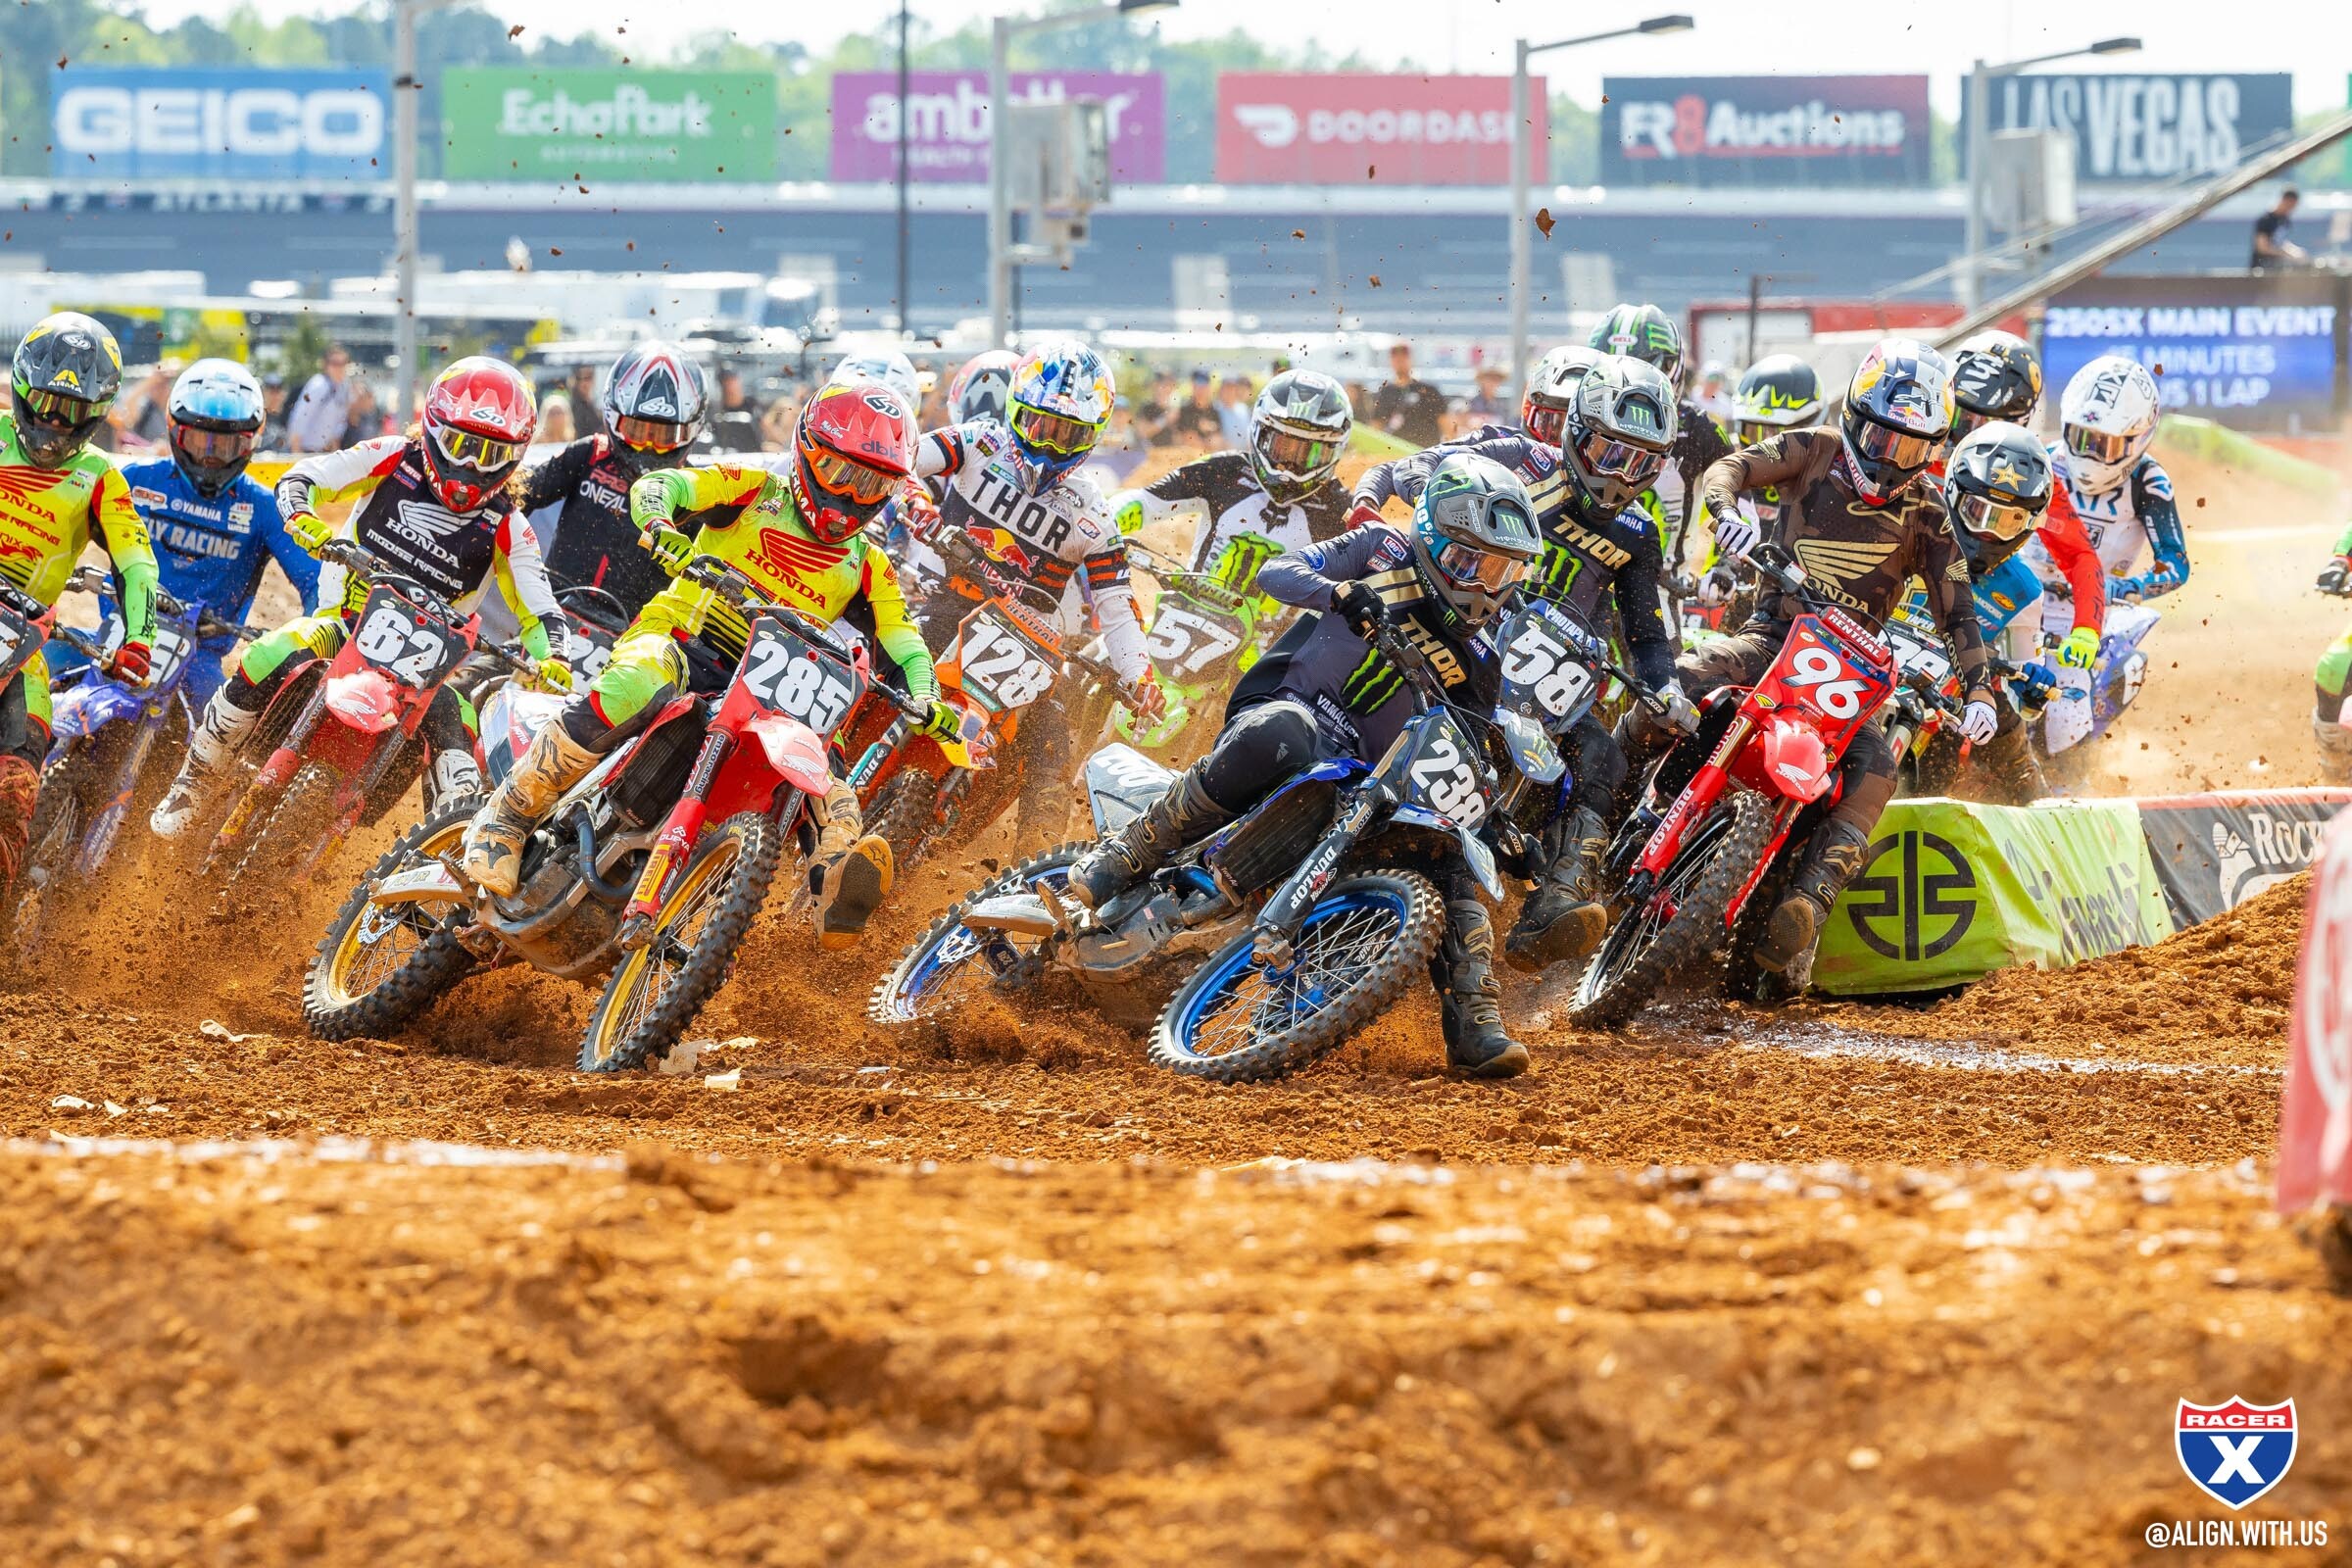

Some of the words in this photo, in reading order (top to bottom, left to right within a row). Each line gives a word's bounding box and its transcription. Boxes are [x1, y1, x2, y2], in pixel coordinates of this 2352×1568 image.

[56, 85, 384, 155] GEICO
[502, 84, 712, 136] EchoPark
[1707, 101, 1905, 148] Auctions
[2084, 76, 2241, 176] VEGAS
[2147, 306, 2231, 337] MAIN
[2234, 306, 2337, 336] EVENT
[2143, 344, 2277, 375] MINUTES
[2211, 377, 2272, 408] LAP
[1887, 412, 1907, 424] Red
[1907, 417, 1926, 430] Bull
[860, 440, 900, 461] dbk
[0, 490, 57, 524] ONDA
[182, 501, 221, 522] YAMAHA
[971, 468, 1072, 554] THOR
[1615, 514, 1644, 532] MAHA
[169, 525, 242, 560] RACING
[366, 527, 415, 564] MOOSE
[413, 558, 464, 590] RACING
[385, 516, 461, 569] HONDA
[1386, 537, 1406, 560] 100%
[1552, 514, 1633, 571] THOR
[743, 548, 827, 611] HONDA
[1801, 575, 1870, 613] ONDA
[1005, 602, 1056, 645] RENTHAL
[1148, 604, 1242, 674] 57
[1829, 613, 1882, 659] RENTHAL
[357, 608, 448, 690] 62
[960, 619, 1057, 709] 128
[1500, 628, 1592, 717] 58
[742, 639, 853, 735] 285
[1293, 696, 1316, 715] YAMAHA
[1780, 646, 1873, 720] 96
[1799, 696, 1825, 717] HONDA
[510, 724, 531, 749] MOTUL
[1409, 738, 1486, 829] 238
[1776, 768, 1806, 796] HONDA
[1648, 787, 1695, 857] DUNLOP
[1289, 845, 1338, 910] DUNLOP
